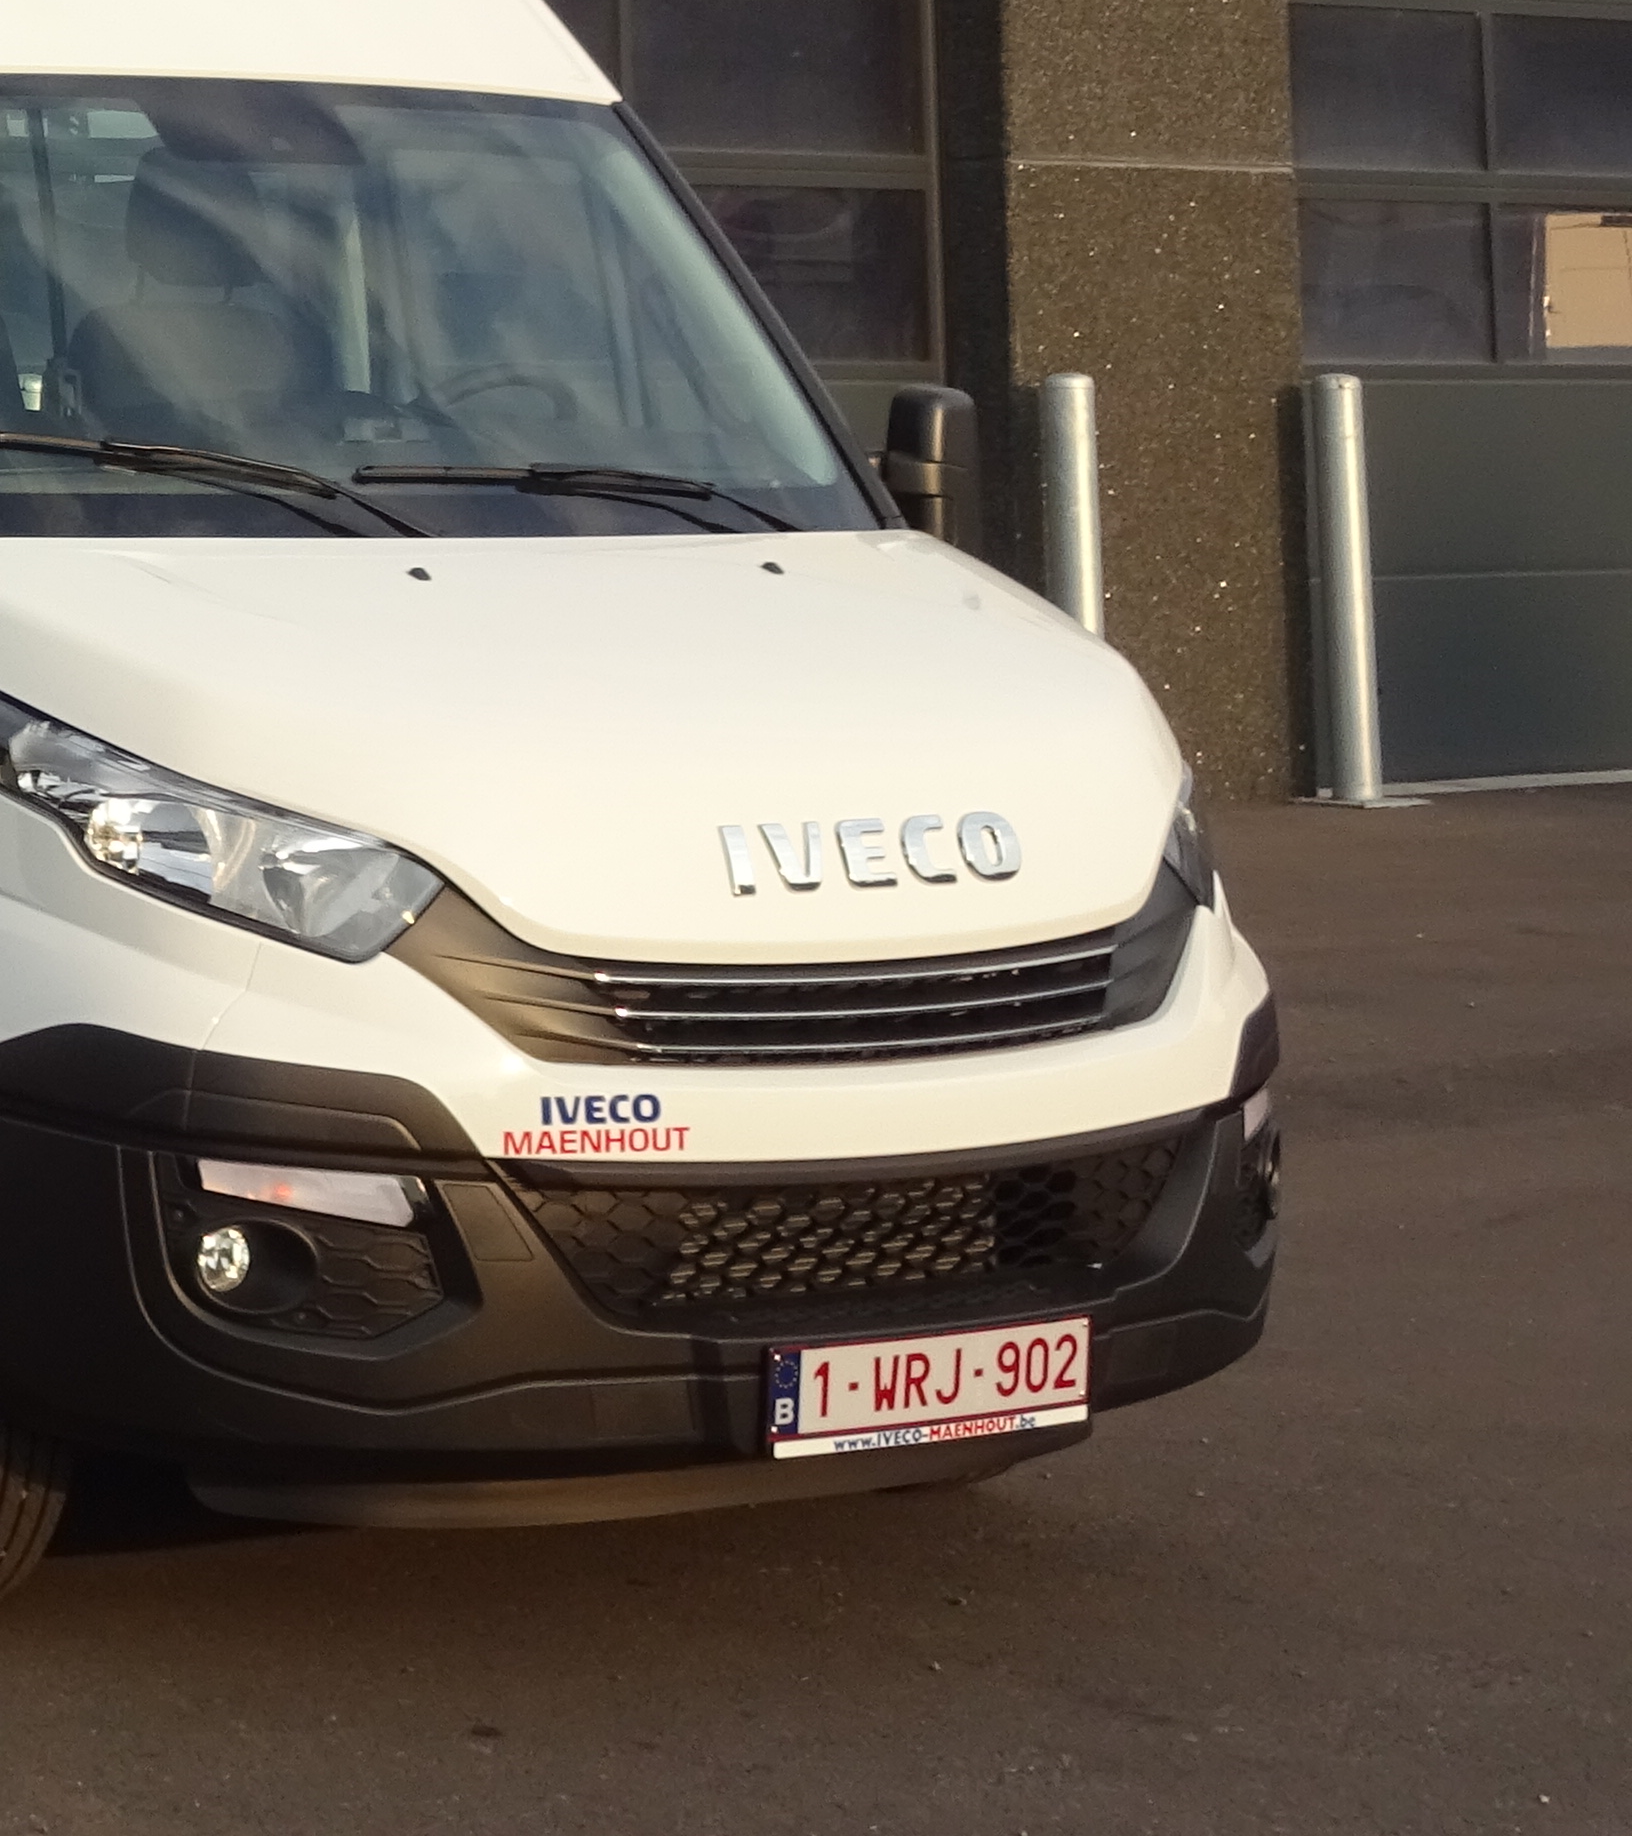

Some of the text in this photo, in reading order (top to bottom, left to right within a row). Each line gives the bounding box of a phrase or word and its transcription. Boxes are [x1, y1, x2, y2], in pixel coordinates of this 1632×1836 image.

[718, 811, 1022, 897] IVECO
[540, 1093, 661, 1126] IVECO
[503, 1127, 690, 1156] MAENHOUT
[813, 1333, 1078, 1418] 1-WRJ-902
[774, 1397, 794, 1425] B
[833, 1413, 1037, 1452] www.IVECO-MAENHOUT.be
